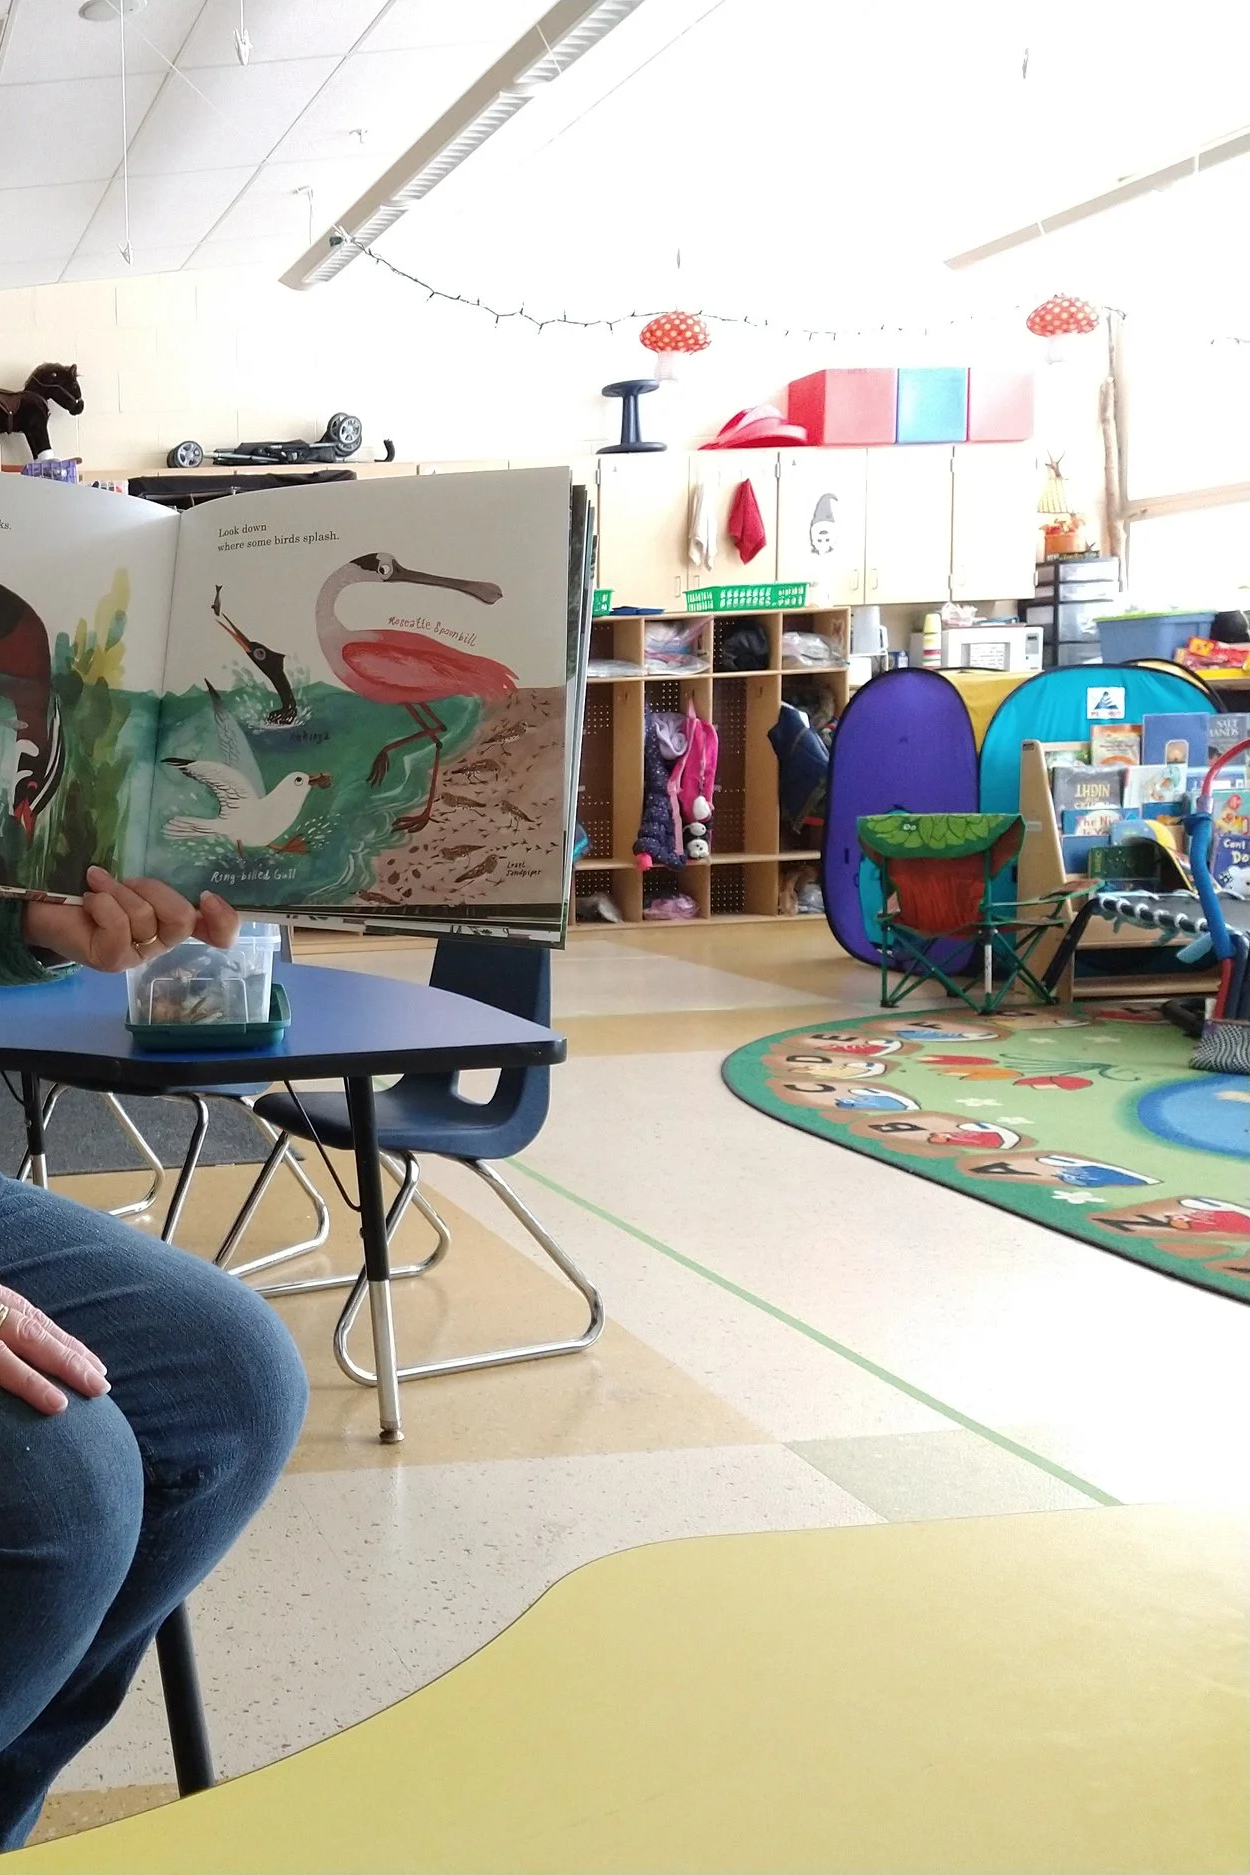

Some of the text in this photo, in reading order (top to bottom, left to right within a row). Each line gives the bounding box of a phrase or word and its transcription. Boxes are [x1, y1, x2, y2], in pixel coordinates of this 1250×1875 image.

[218, 524, 267, 538] Look down
[218, 531, 340, 552] where some birds splash.
[1074, 783, 1110, 798] NIGHT
[211, 869, 270, 885] Ring-billed
[811, 1034, 859, 1042] E
[786, 1055, 832, 1064] D
[783, 1083, 836, 1093] C
[868, 1122, 927, 1133] B
[969, 1162, 1042, 1176] A
